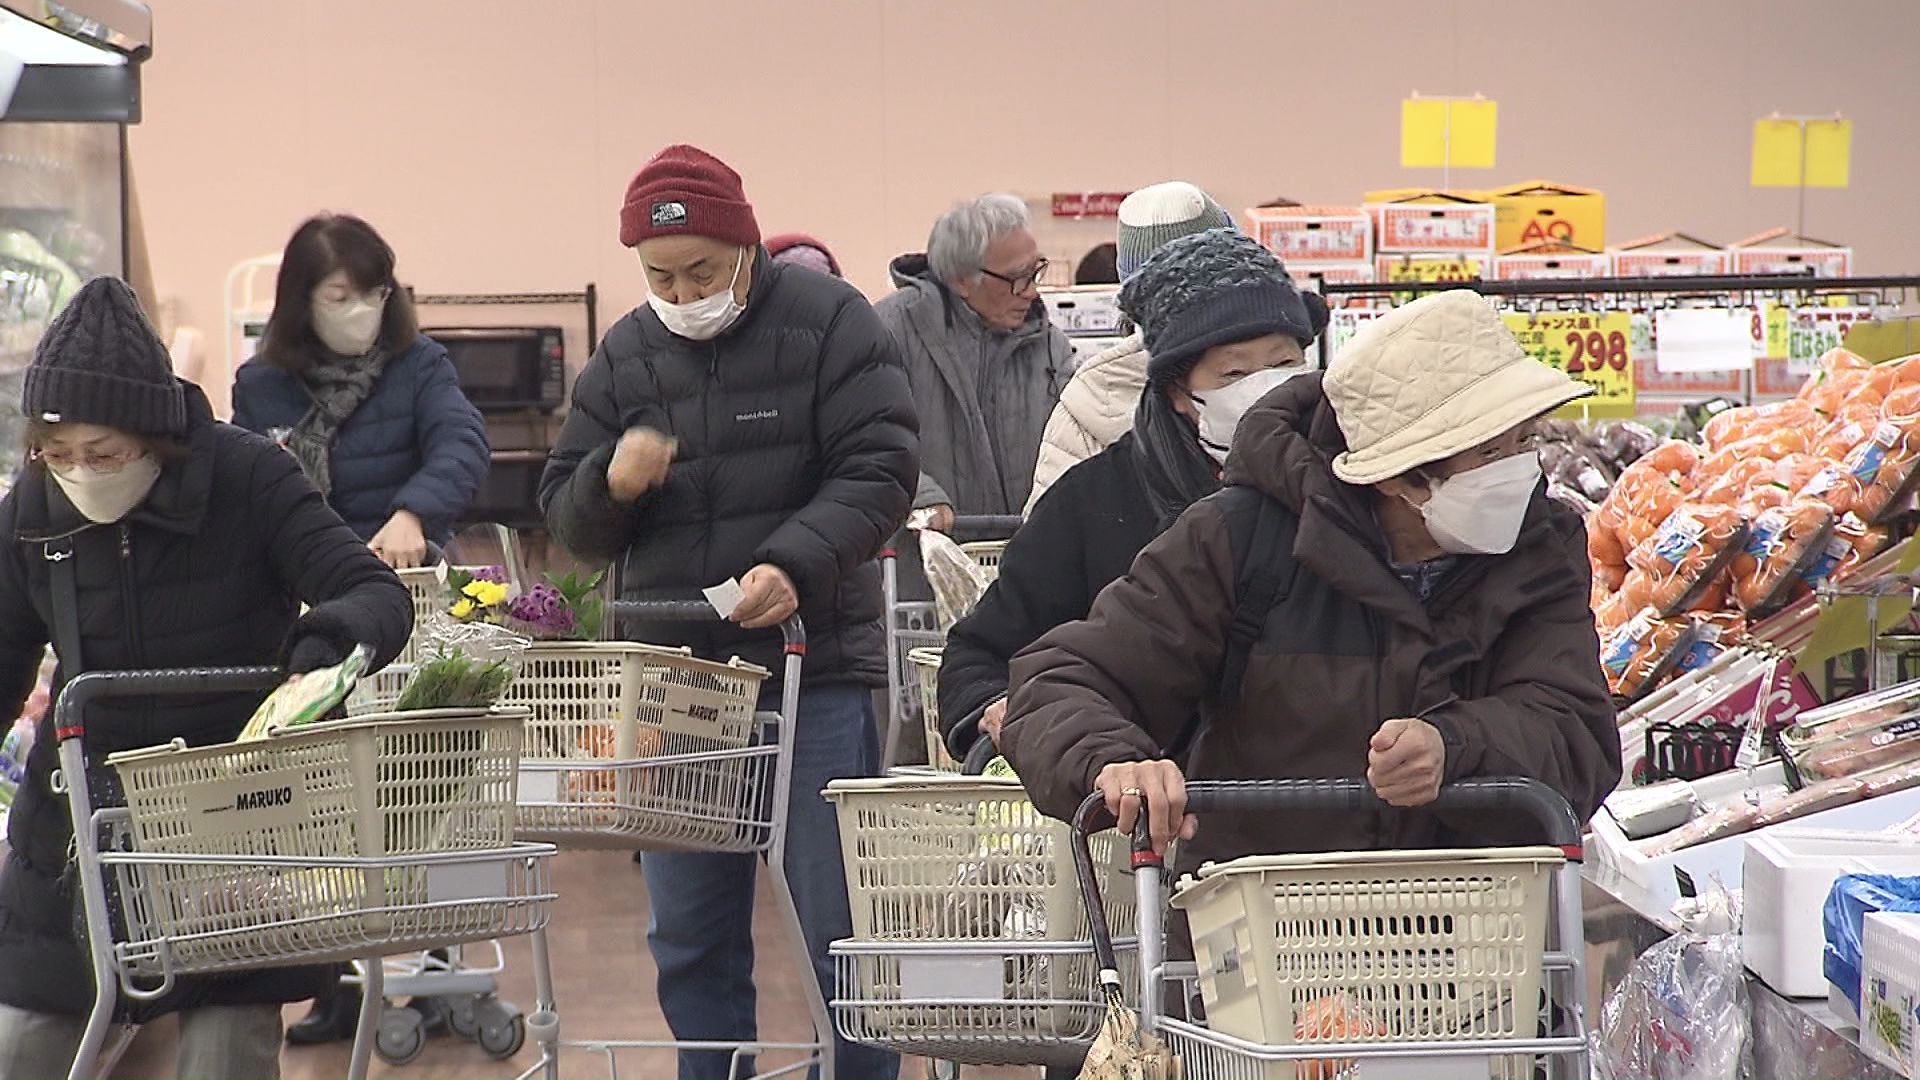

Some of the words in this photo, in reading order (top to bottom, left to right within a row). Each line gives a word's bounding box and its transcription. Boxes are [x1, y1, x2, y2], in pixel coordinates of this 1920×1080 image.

[1566, 330, 1627, 372] 298
[687, 703, 719, 722] MARUKO
[236, 786, 292, 811] MARUKO
